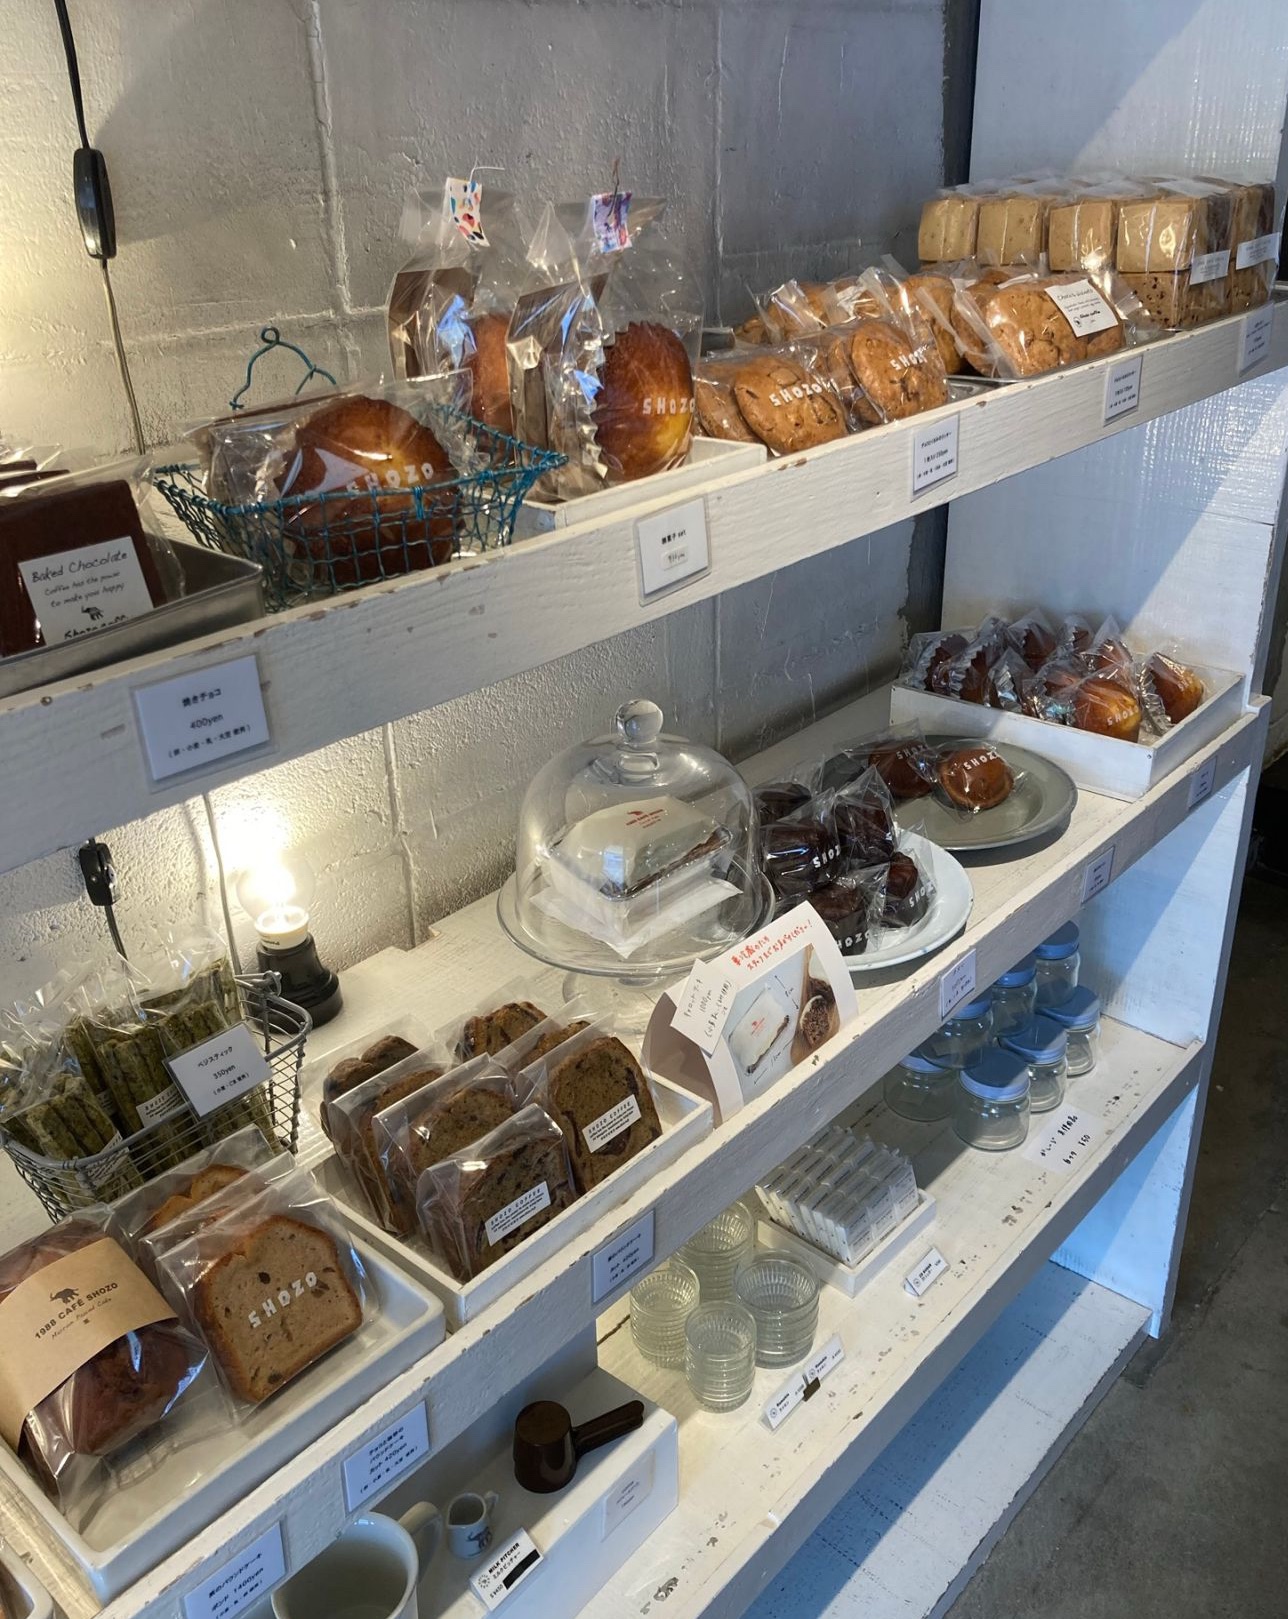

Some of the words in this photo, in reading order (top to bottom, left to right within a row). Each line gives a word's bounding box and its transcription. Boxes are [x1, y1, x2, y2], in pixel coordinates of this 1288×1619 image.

[32, 565, 63, 583] Baked
[68, 550, 128, 573] Chocolate
[190, 714, 223, 730] 400yen
[212, 1064, 237, 1080] 350yen
[35, 1318, 57, 1340] 1988
[58, 1298, 85, 1320] CAFÉ
[86, 1282, 119, 1302] SHOZO
[248, 1271, 318, 1329] SHOZO
[488, 1561, 501, 1574] MILK
[500, 1542, 520, 1563] PITCHER
